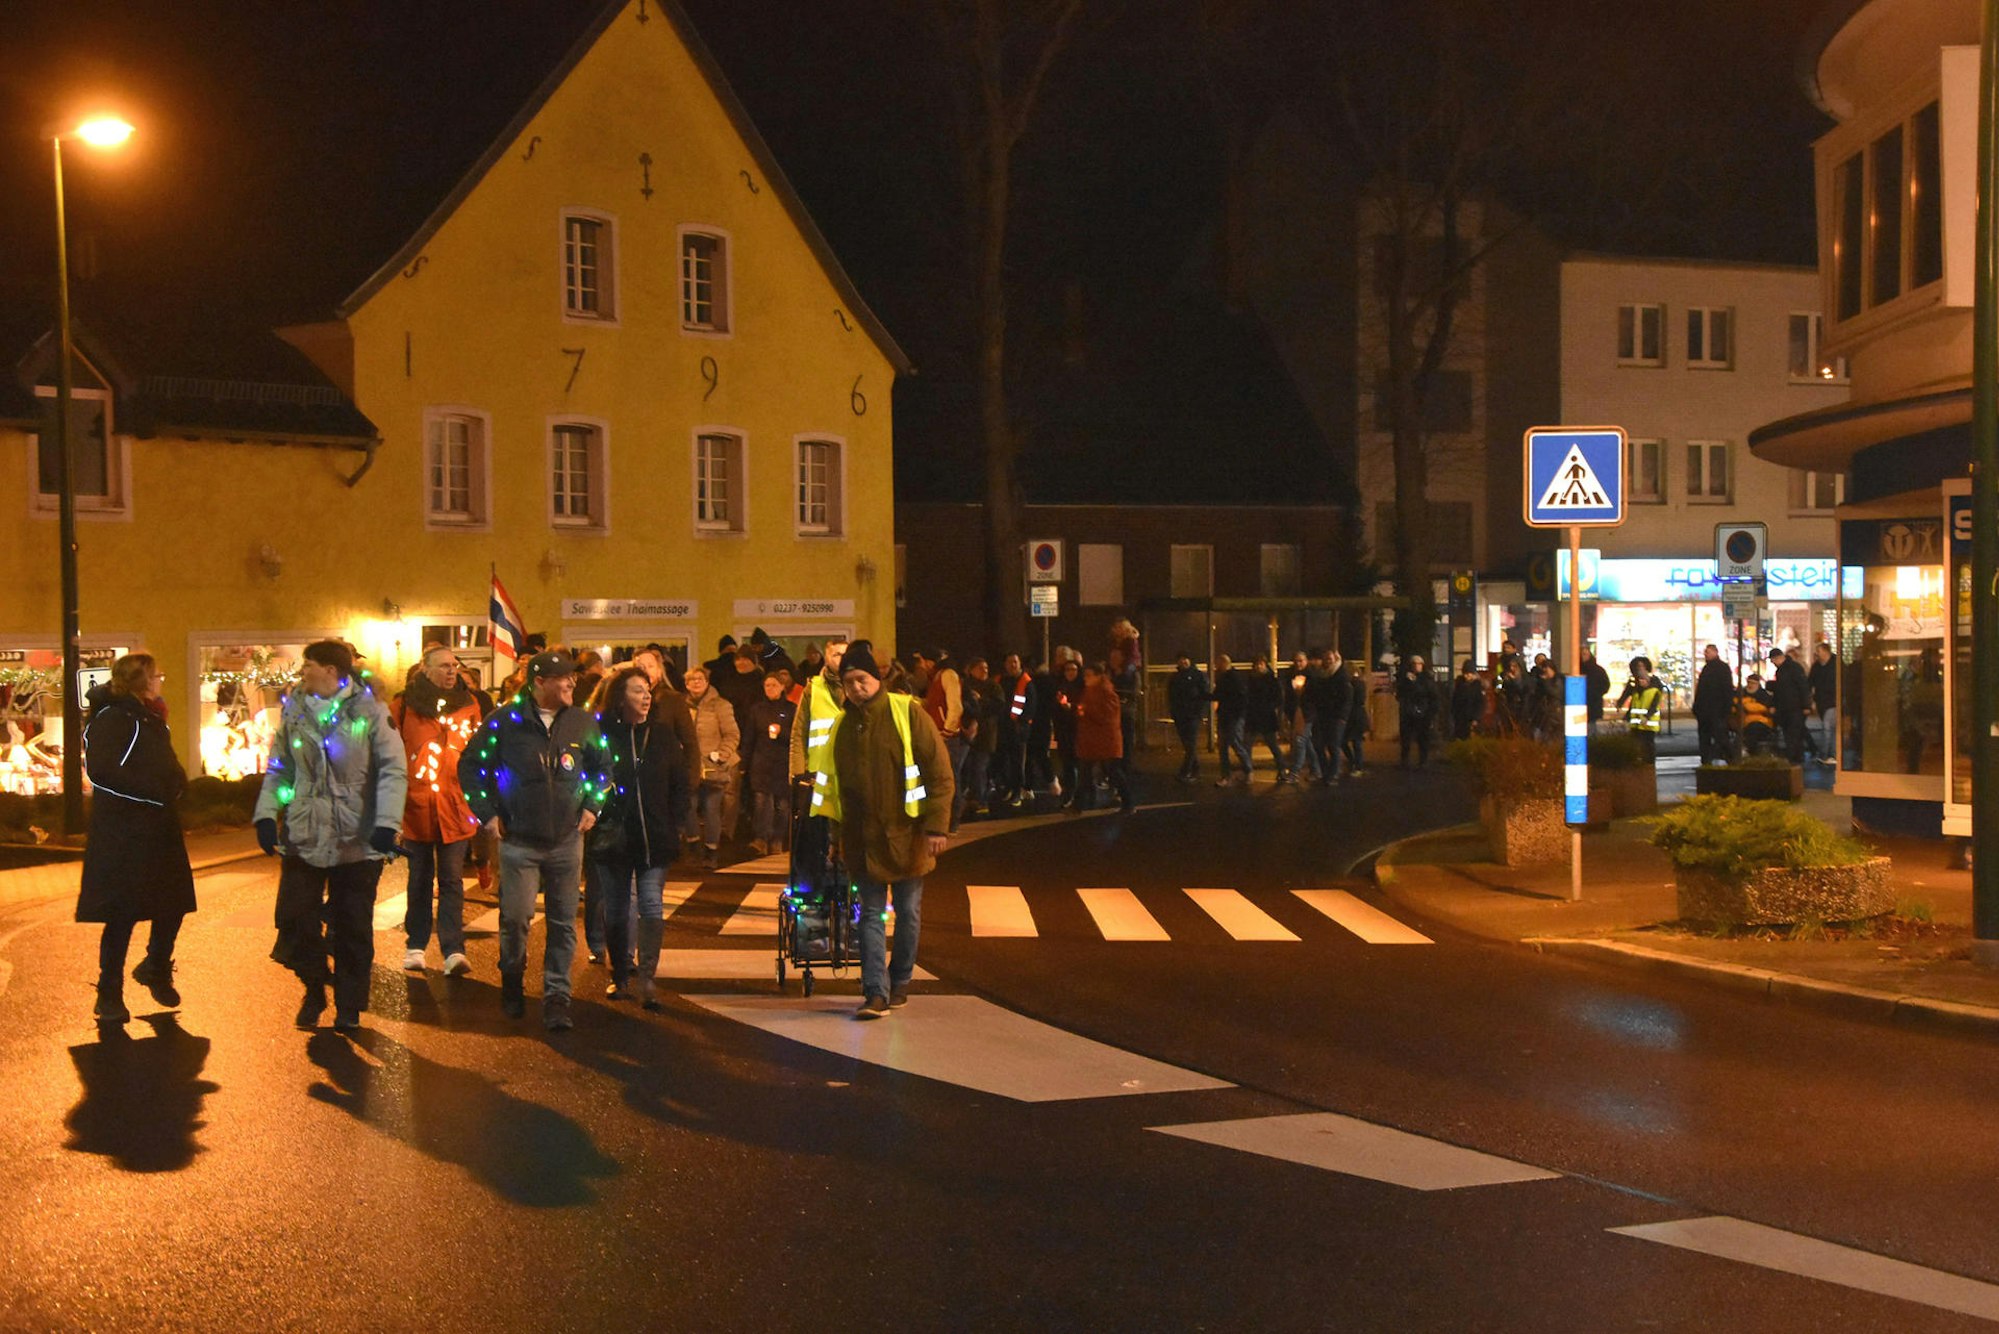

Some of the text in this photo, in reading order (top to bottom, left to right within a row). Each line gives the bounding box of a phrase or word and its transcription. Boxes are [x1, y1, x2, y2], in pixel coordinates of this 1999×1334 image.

[561, 348, 586, 394] 7
[699, 355, 719, 402] 9
[850, 374, 867, 416] 6
[1665, 560, 1846, 587] ravstein
[1729, 565, 1753, 575] ZONE
[627, 603, 689, 616] Thaimassage
